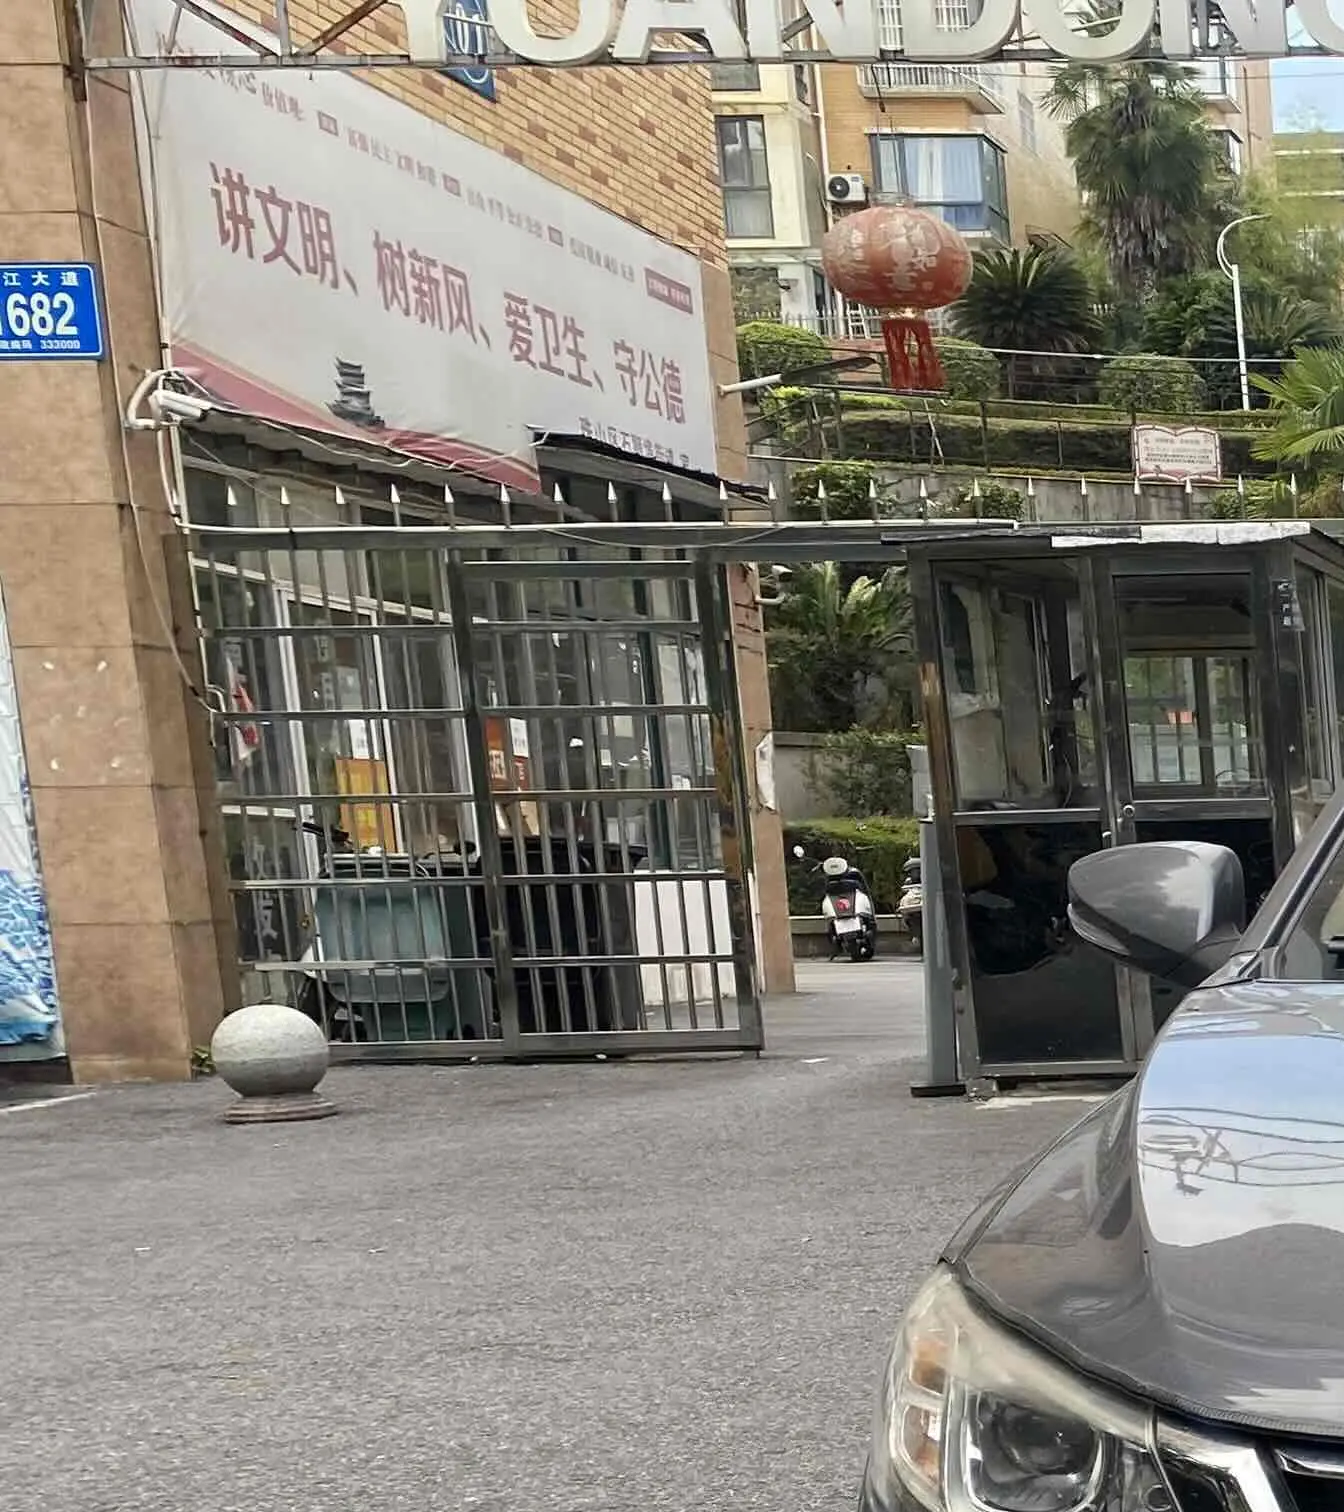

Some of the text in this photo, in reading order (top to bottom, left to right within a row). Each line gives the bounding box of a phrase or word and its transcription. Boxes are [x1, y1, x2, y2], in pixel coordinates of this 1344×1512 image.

[2, 271, 79, 287] 江大道
[0, 292, 78, 337] 682
